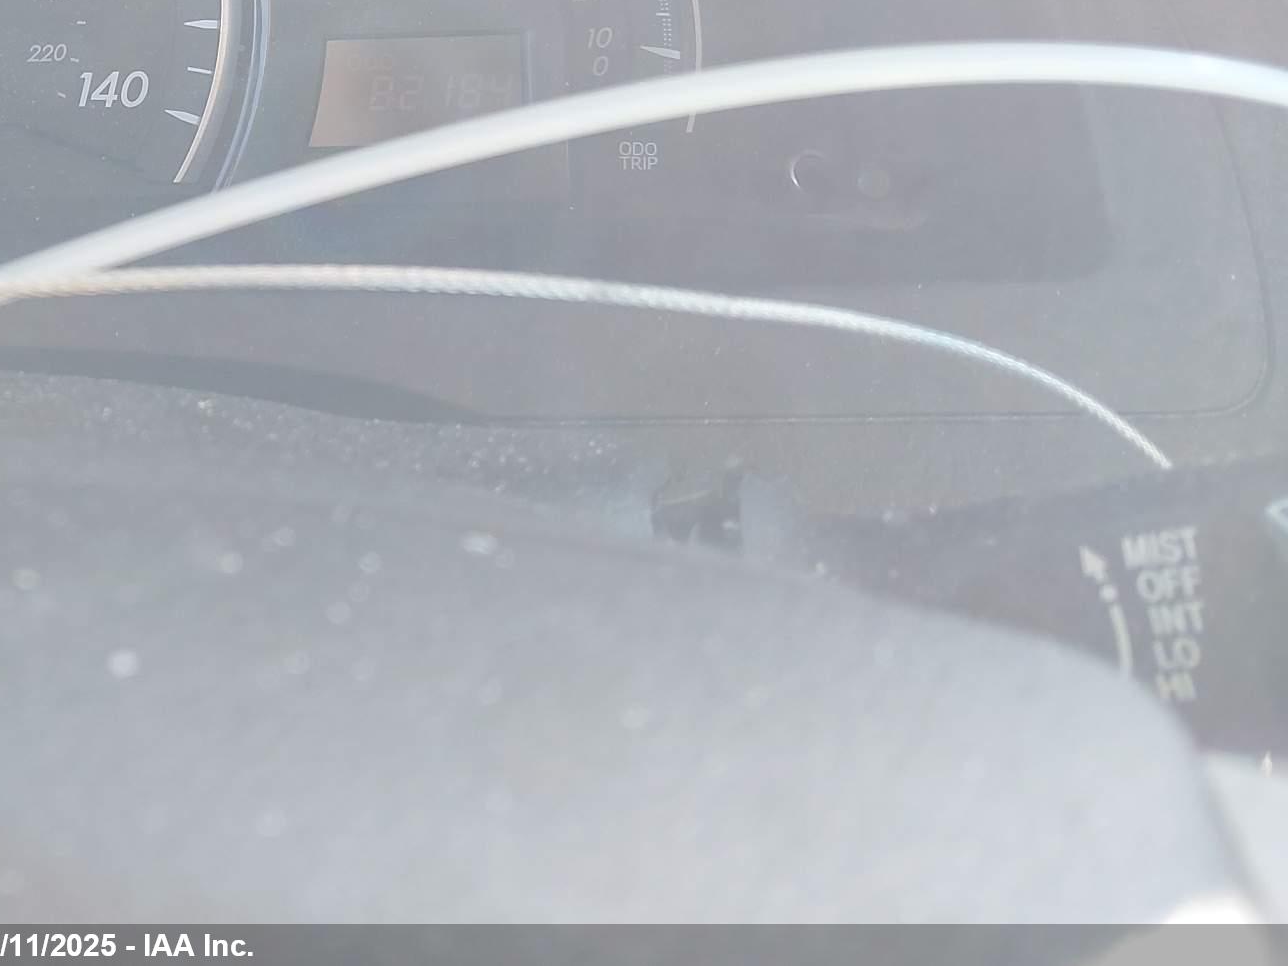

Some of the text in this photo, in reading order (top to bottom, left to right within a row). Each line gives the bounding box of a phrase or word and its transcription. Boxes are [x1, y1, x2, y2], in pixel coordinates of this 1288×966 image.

[587, 27, 613, 49] 10
[26, 44, 68, 63] 220
[592, 56, 609, 78] 0
[77, 70, 150, 109] 140
[618, 140, 657, 157] ODO
[618, 156, 658, 172] TRIP
[1121, 524, 1199, 570] MIST
[1136, 565, 1201, 602] OFF
[1152, 635, 1201, 669] LO
